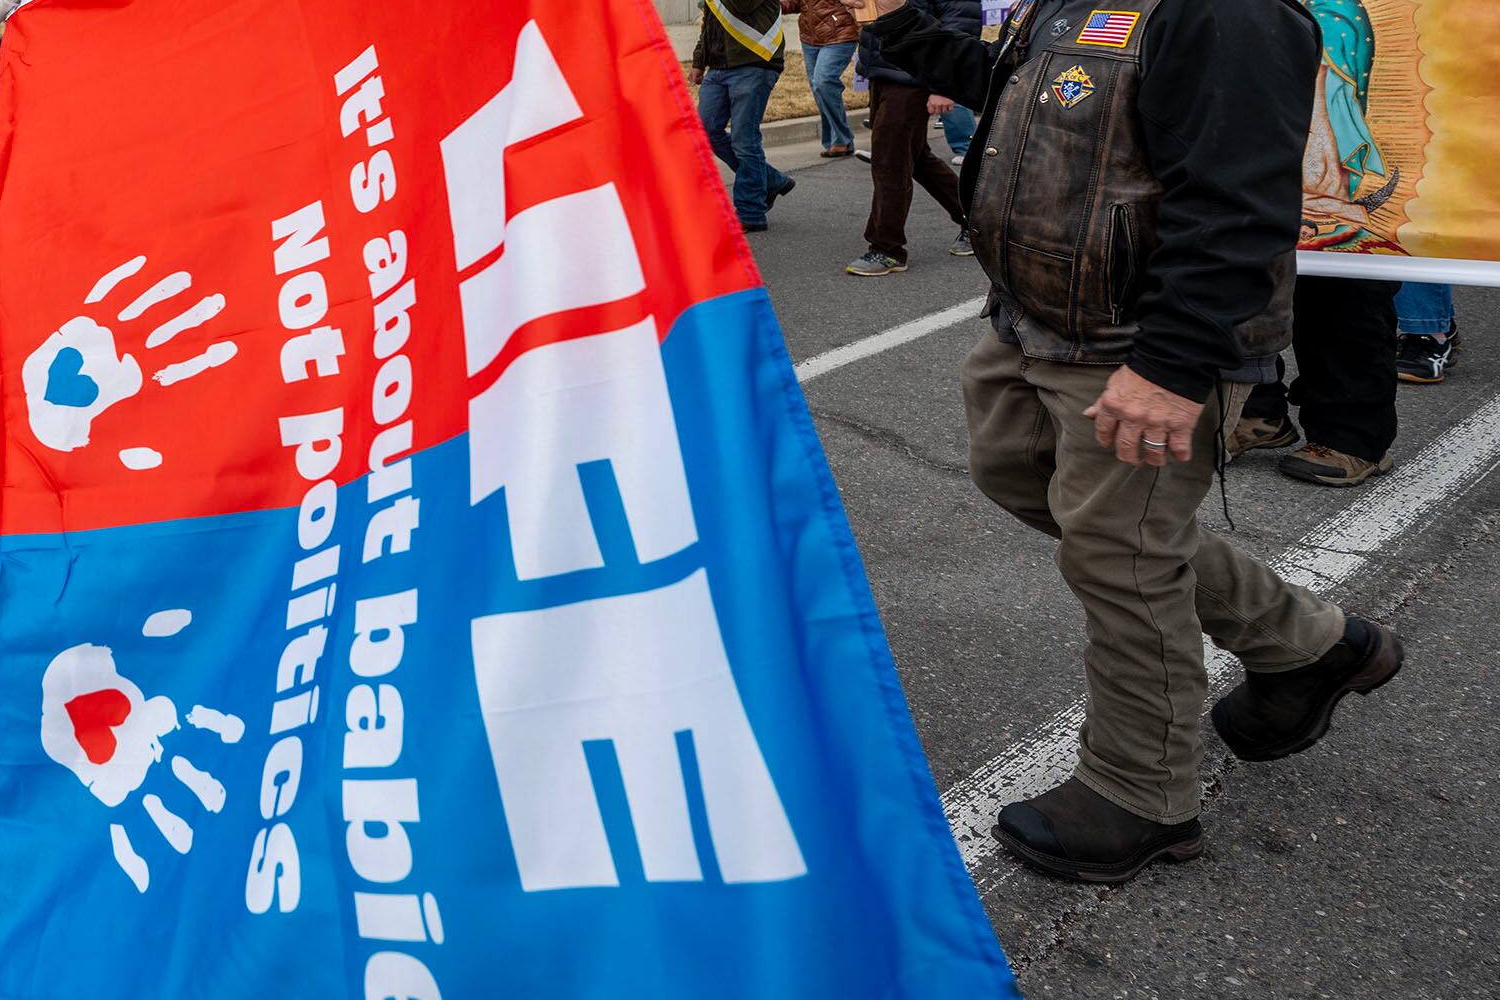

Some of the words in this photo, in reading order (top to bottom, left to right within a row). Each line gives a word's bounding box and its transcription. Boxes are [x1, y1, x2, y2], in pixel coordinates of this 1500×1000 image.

[271, 200, 346, 384] Not
[333, 44, 397, 214] It's
[360, 229, 421, 565] about
[439, 18, 809, 893] LIFE
[245, 406, 344, 915] politics
